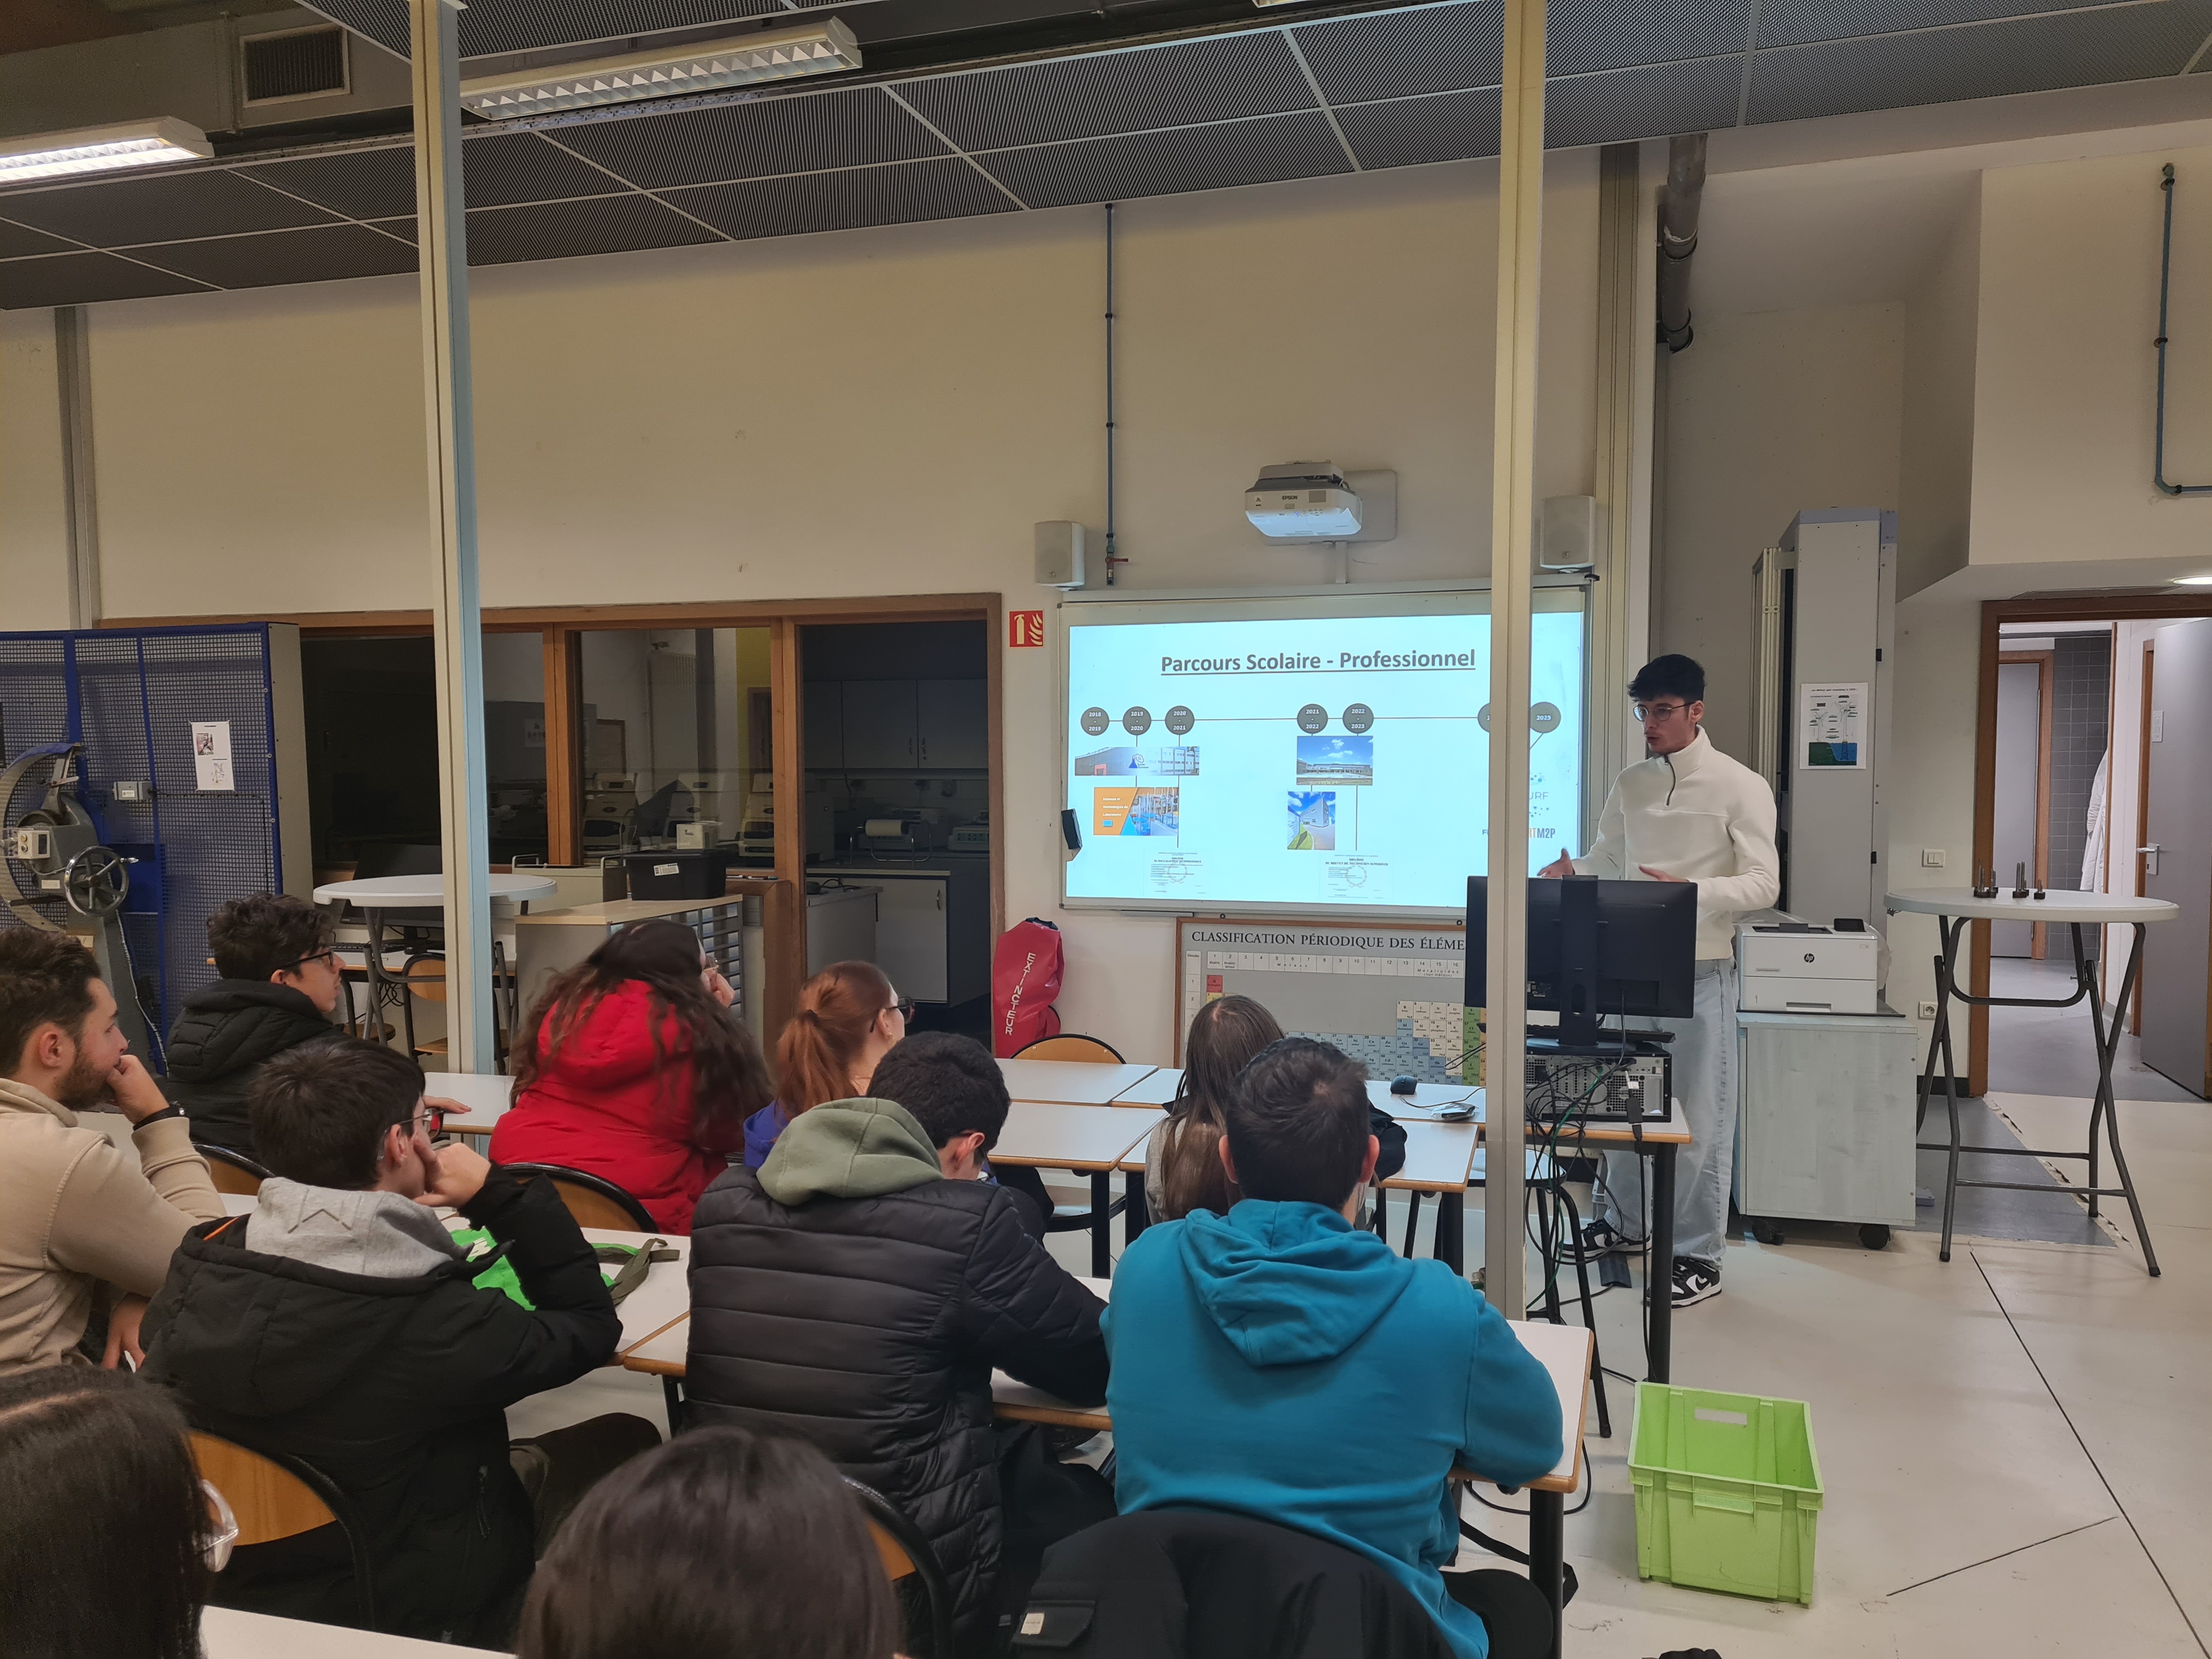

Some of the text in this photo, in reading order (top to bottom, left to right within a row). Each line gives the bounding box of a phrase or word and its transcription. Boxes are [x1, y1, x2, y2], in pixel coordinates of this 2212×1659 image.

[1161, 657, 1240, 672] Parcours
[1246, 652, 1321, 670] Scolaire
[1340, 649, 1475, 668] Professionnel
[1192, 931, 1465, 950] CLASSIFICATION PÉRIODIQUE DES ÉLÉME
[1804, 953, 1814, 963] hp
[1005, 952, 1036, 1036] EXTINCTEUR
